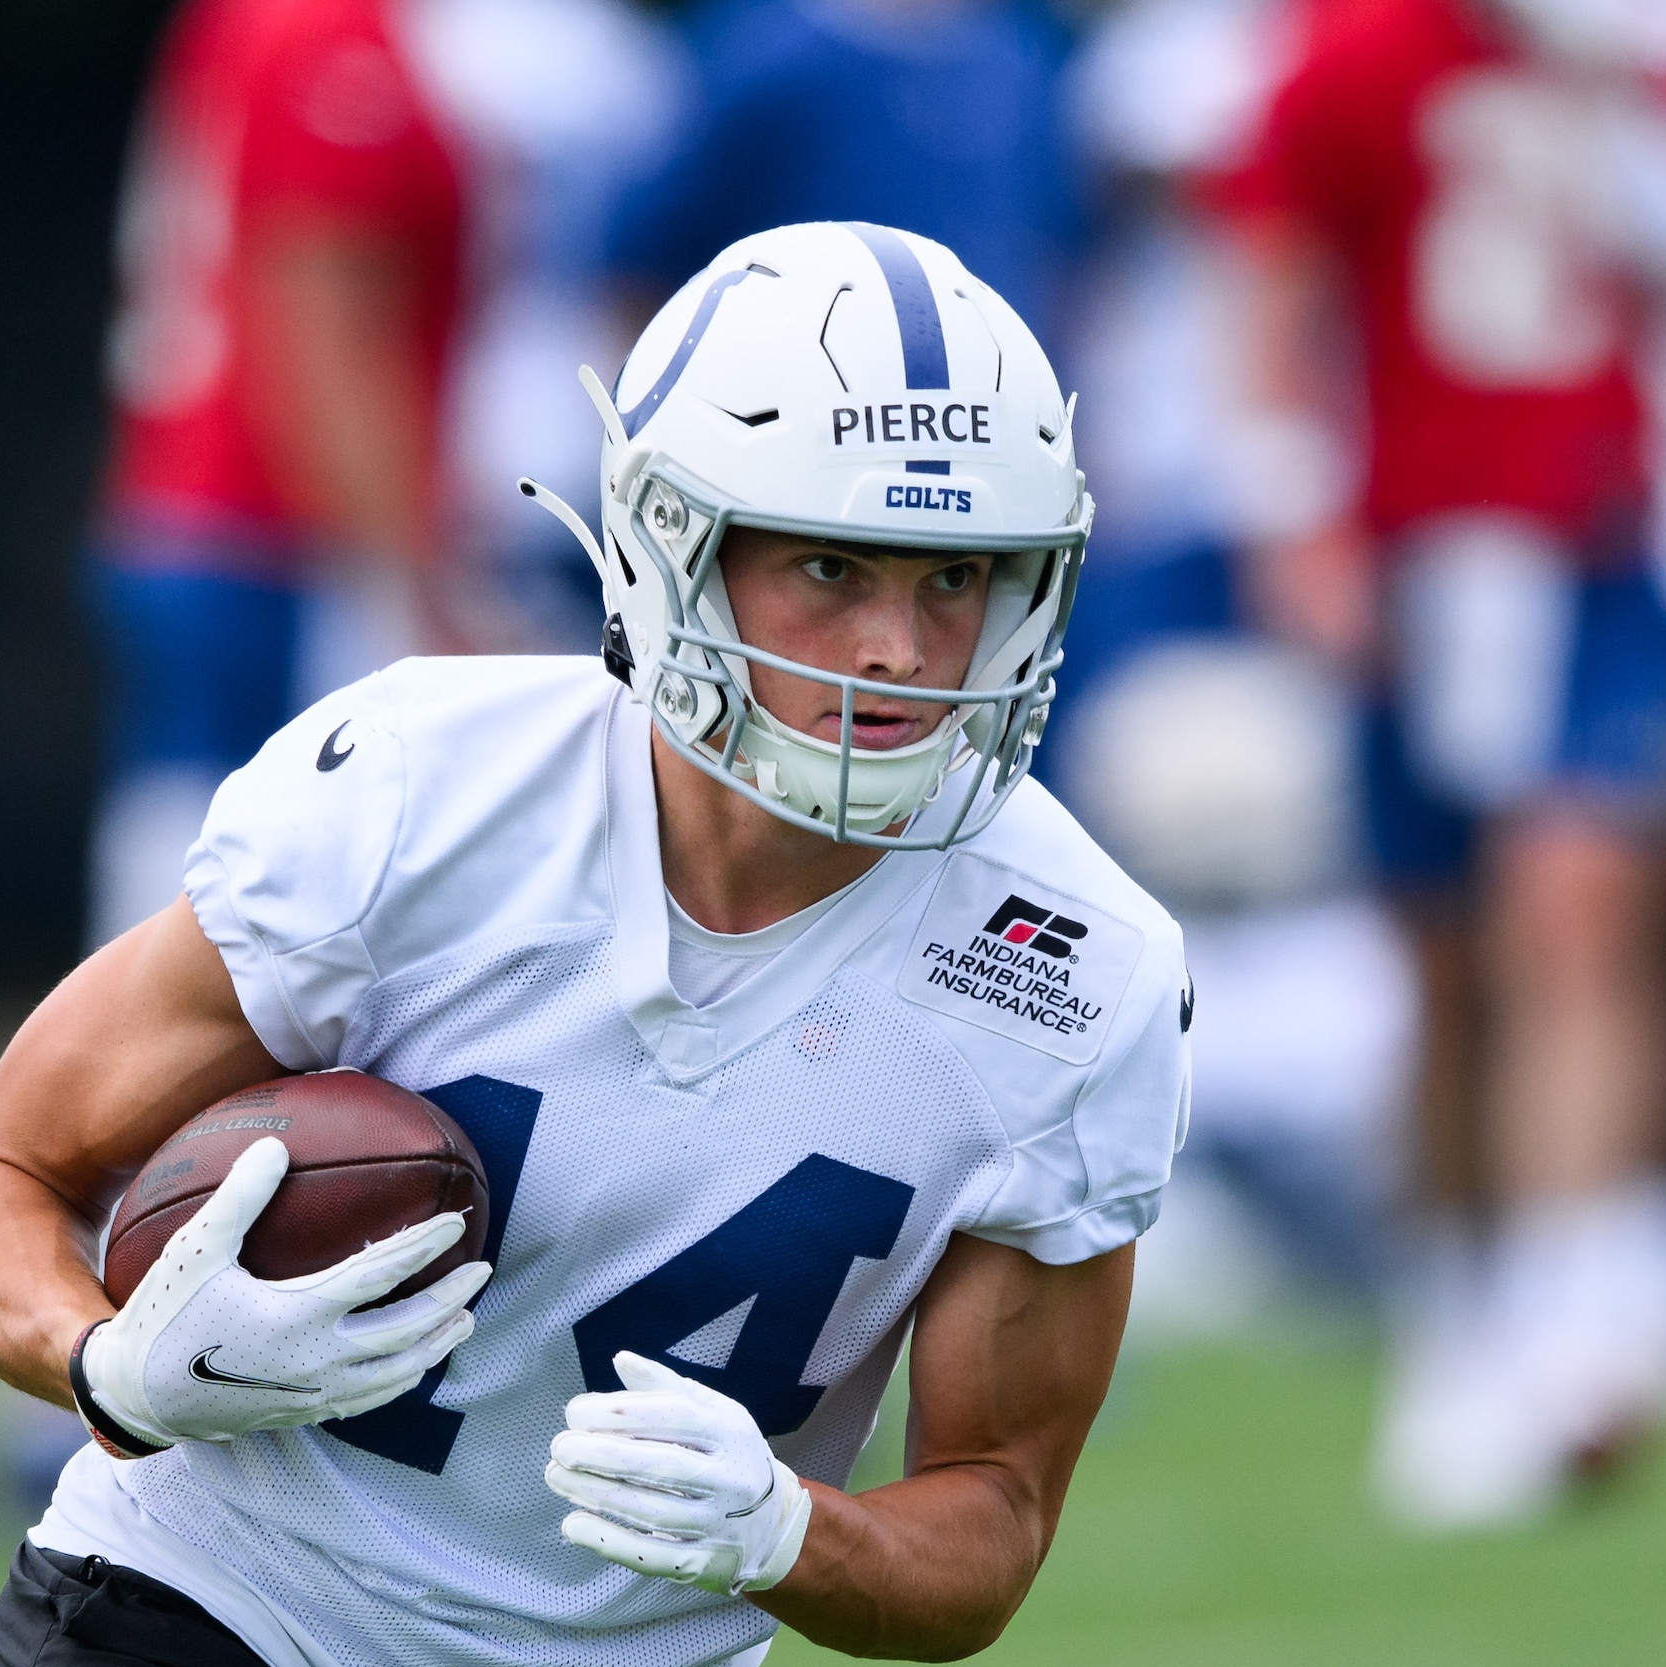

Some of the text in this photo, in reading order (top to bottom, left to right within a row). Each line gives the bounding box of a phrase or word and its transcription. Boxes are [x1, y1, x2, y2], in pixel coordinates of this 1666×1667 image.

[832, 403, 991, 446] PIERCE
[885, 485, 972, 513] COLTS
[921, 942, 1102, 1021] FARMBUREAU
[967, 935, 1071, 988] INDIANA
[225, 1117, 290, 1131] LEAGUE
